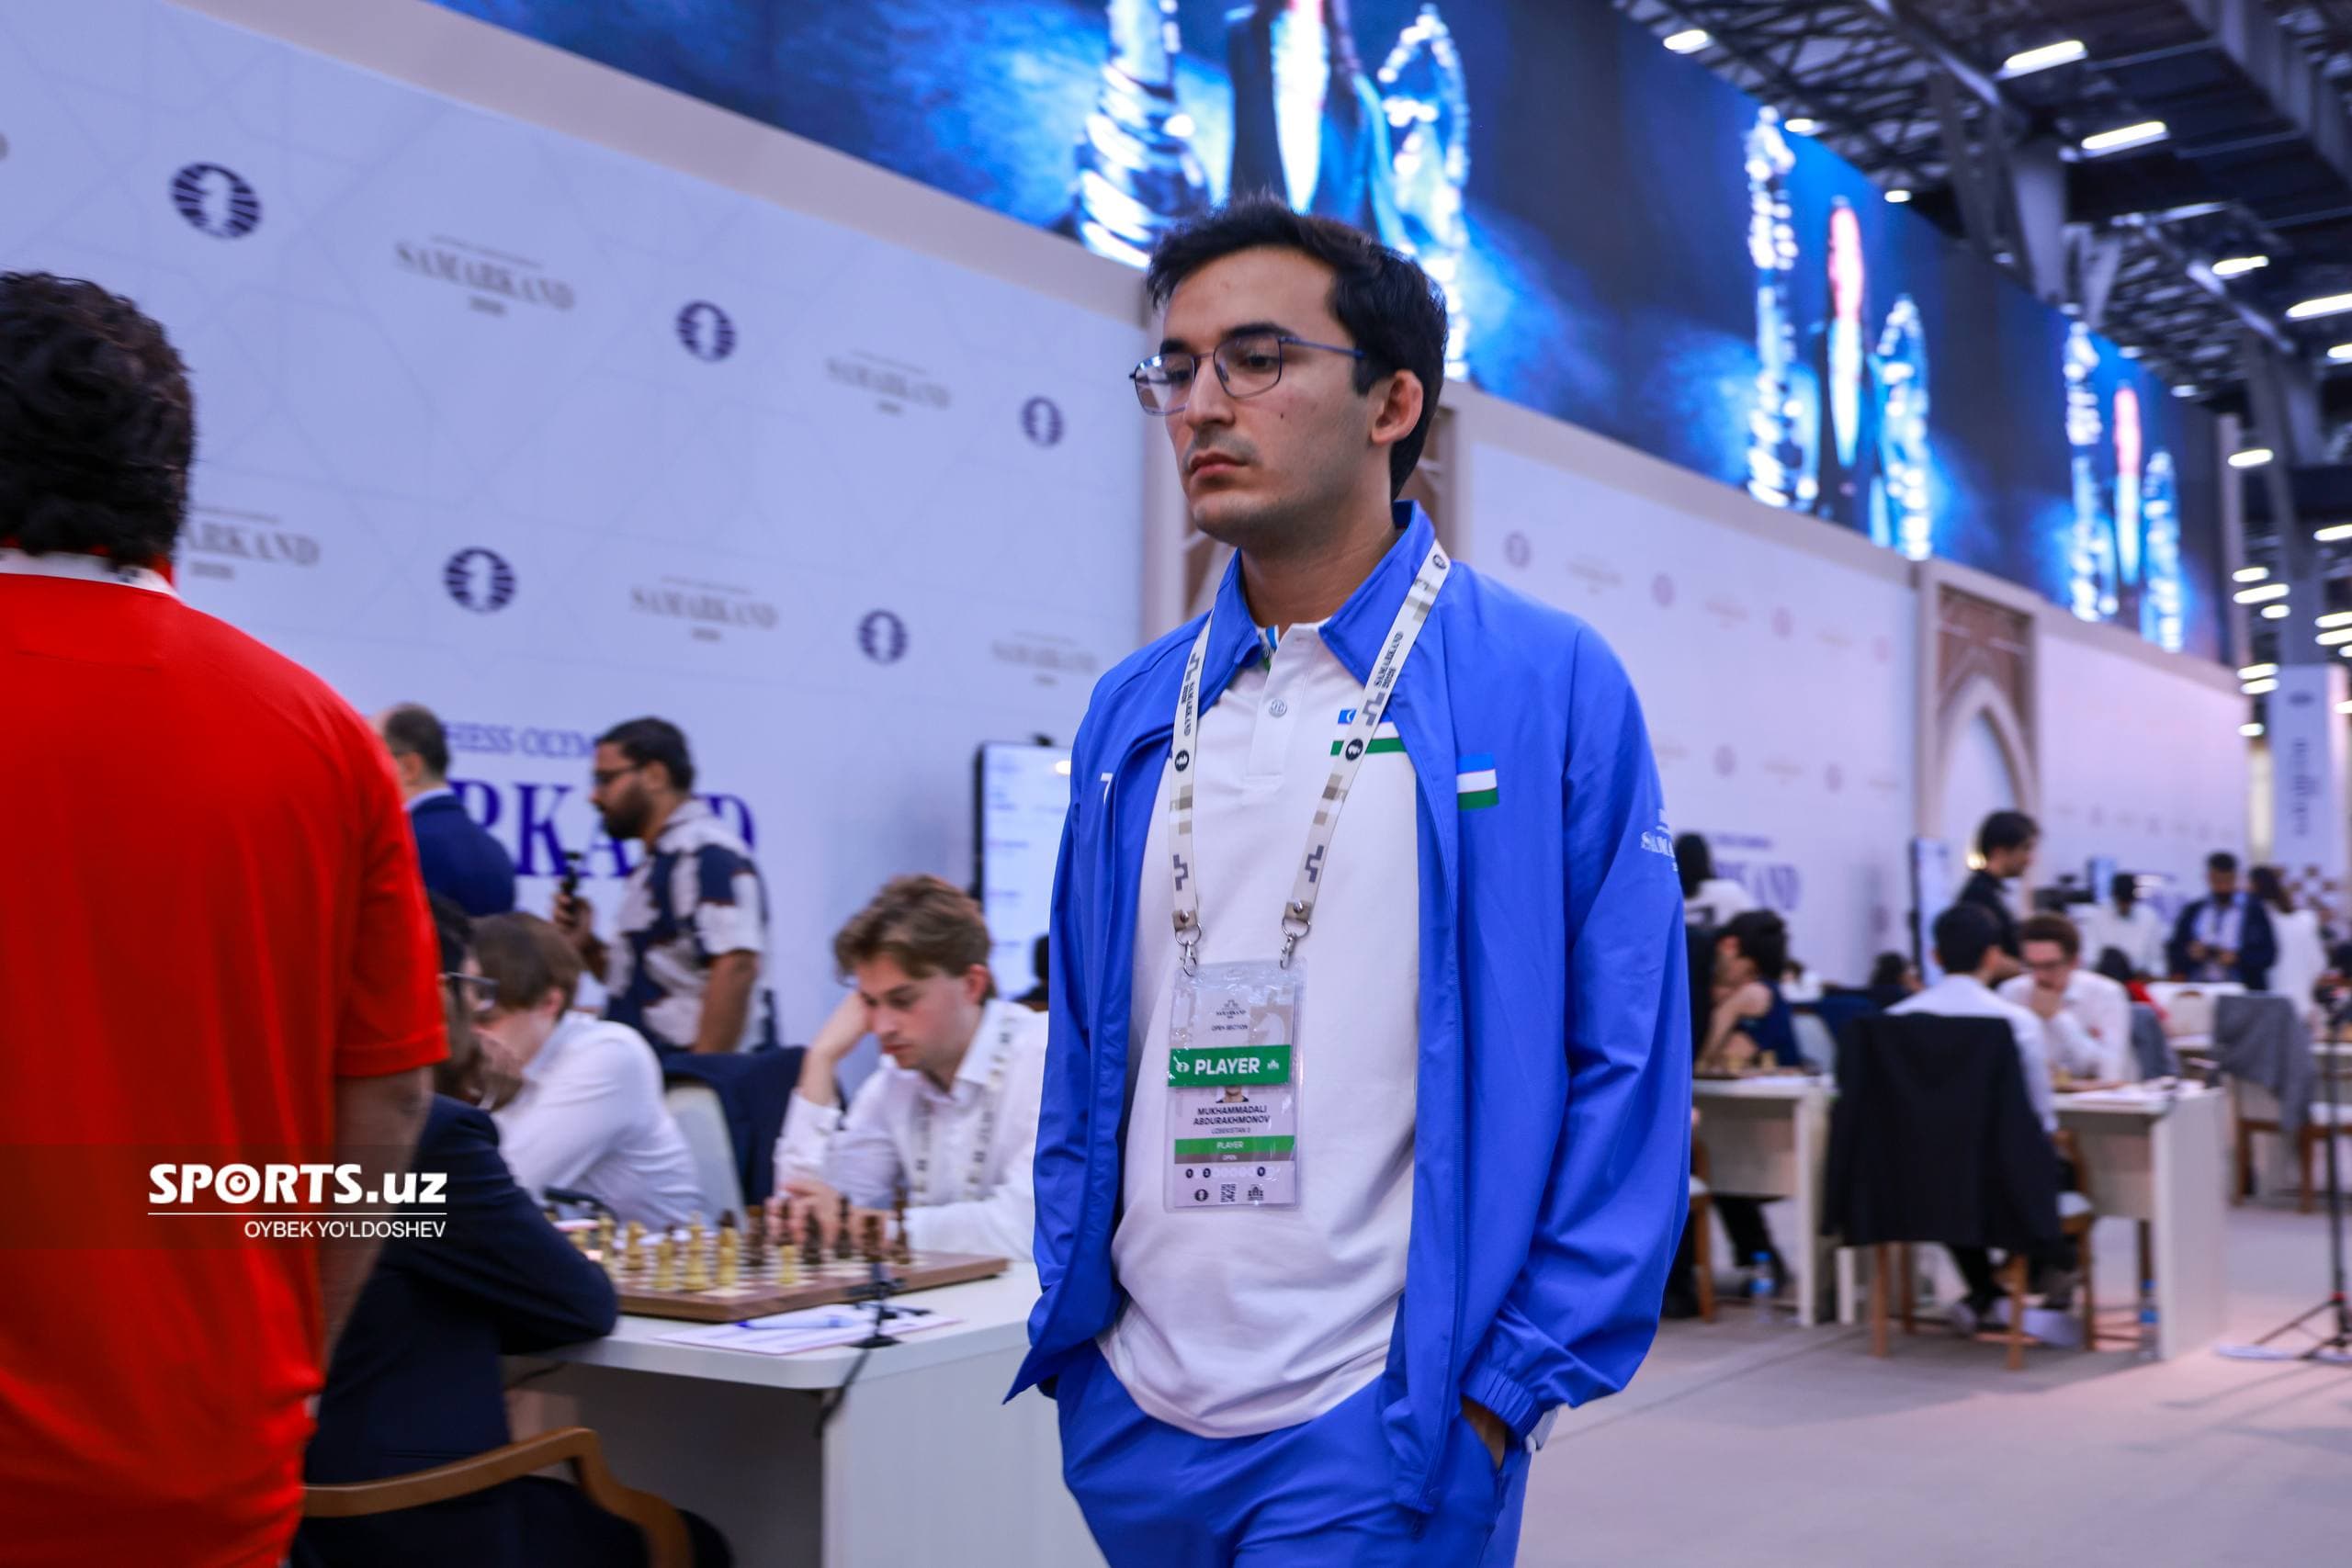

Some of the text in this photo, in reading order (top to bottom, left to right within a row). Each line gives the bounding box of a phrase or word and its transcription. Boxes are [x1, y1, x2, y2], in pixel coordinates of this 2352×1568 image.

[1194, 1057, 1261, 1076] PLAYER
[1197, 1105, 1267, 1115] MUKHAMMADALI
[1193, 1115, 1271, 1125] ABDURAKHMONOV
[1216, 1141, 1244, 1150] PLAYER
